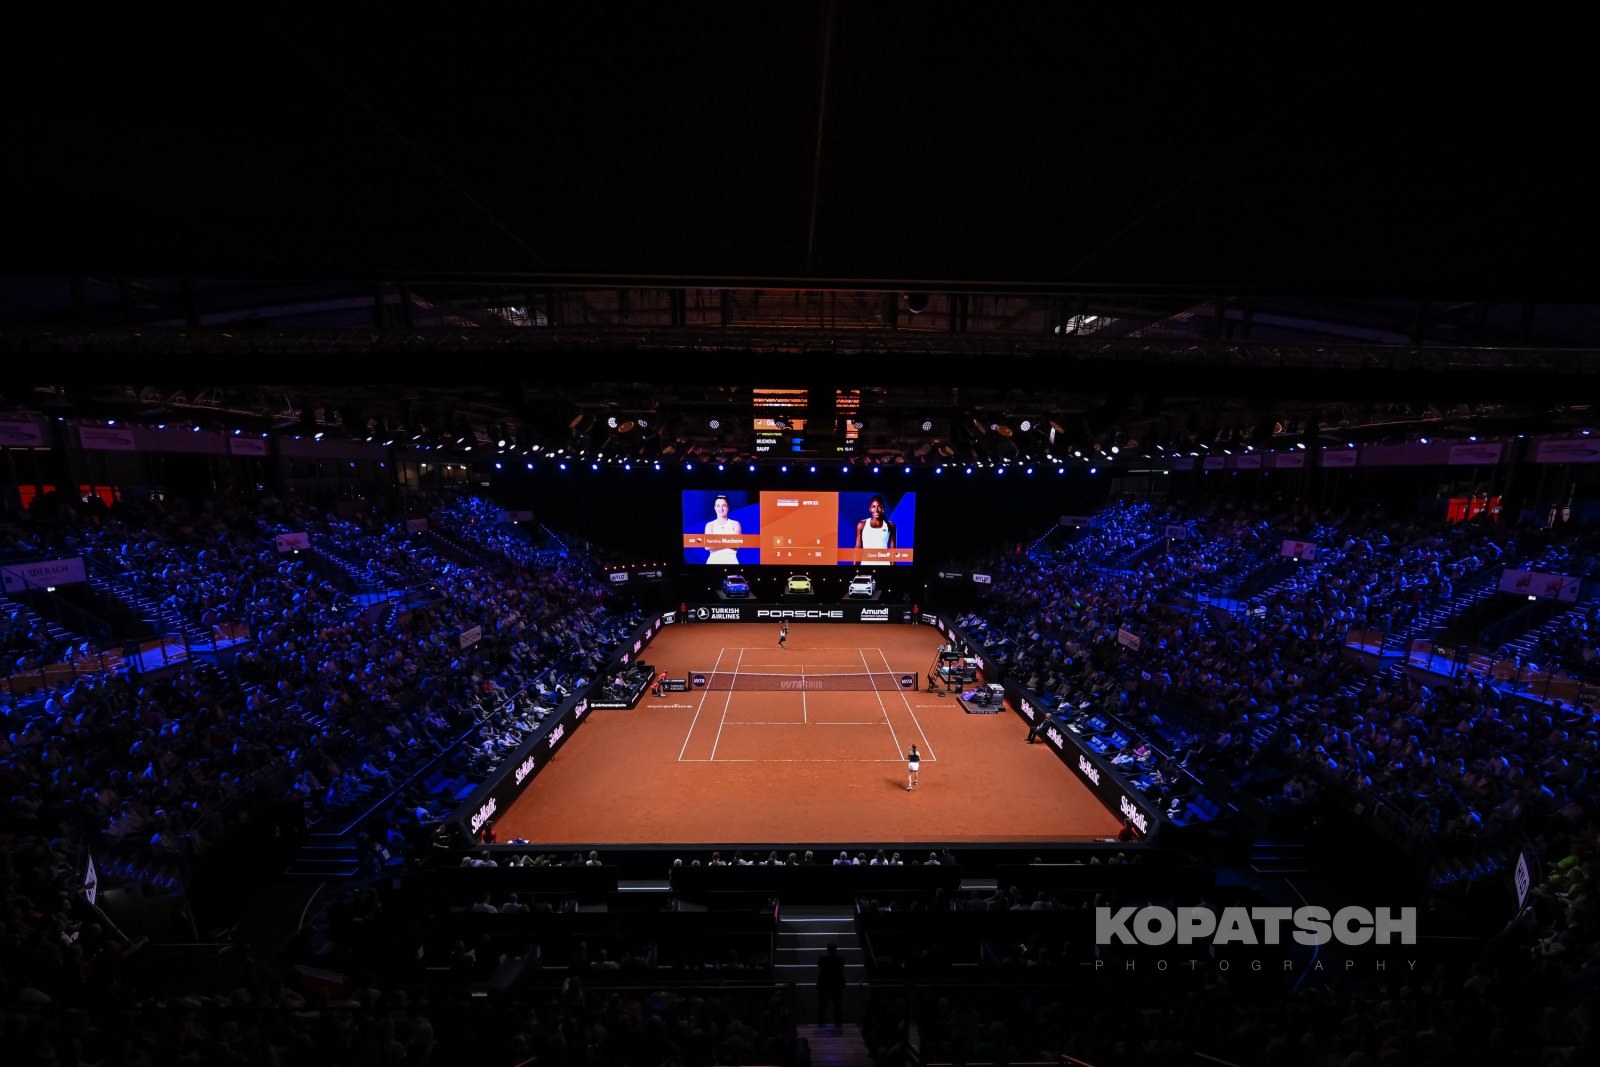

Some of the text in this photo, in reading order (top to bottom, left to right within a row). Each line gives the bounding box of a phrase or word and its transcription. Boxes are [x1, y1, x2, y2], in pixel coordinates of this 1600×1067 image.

[1079, 755, 1099, 786] SieMatic
[471, 797, 497, 834] SieMatic
[1120, 795, 1148, 834] SieMatic
